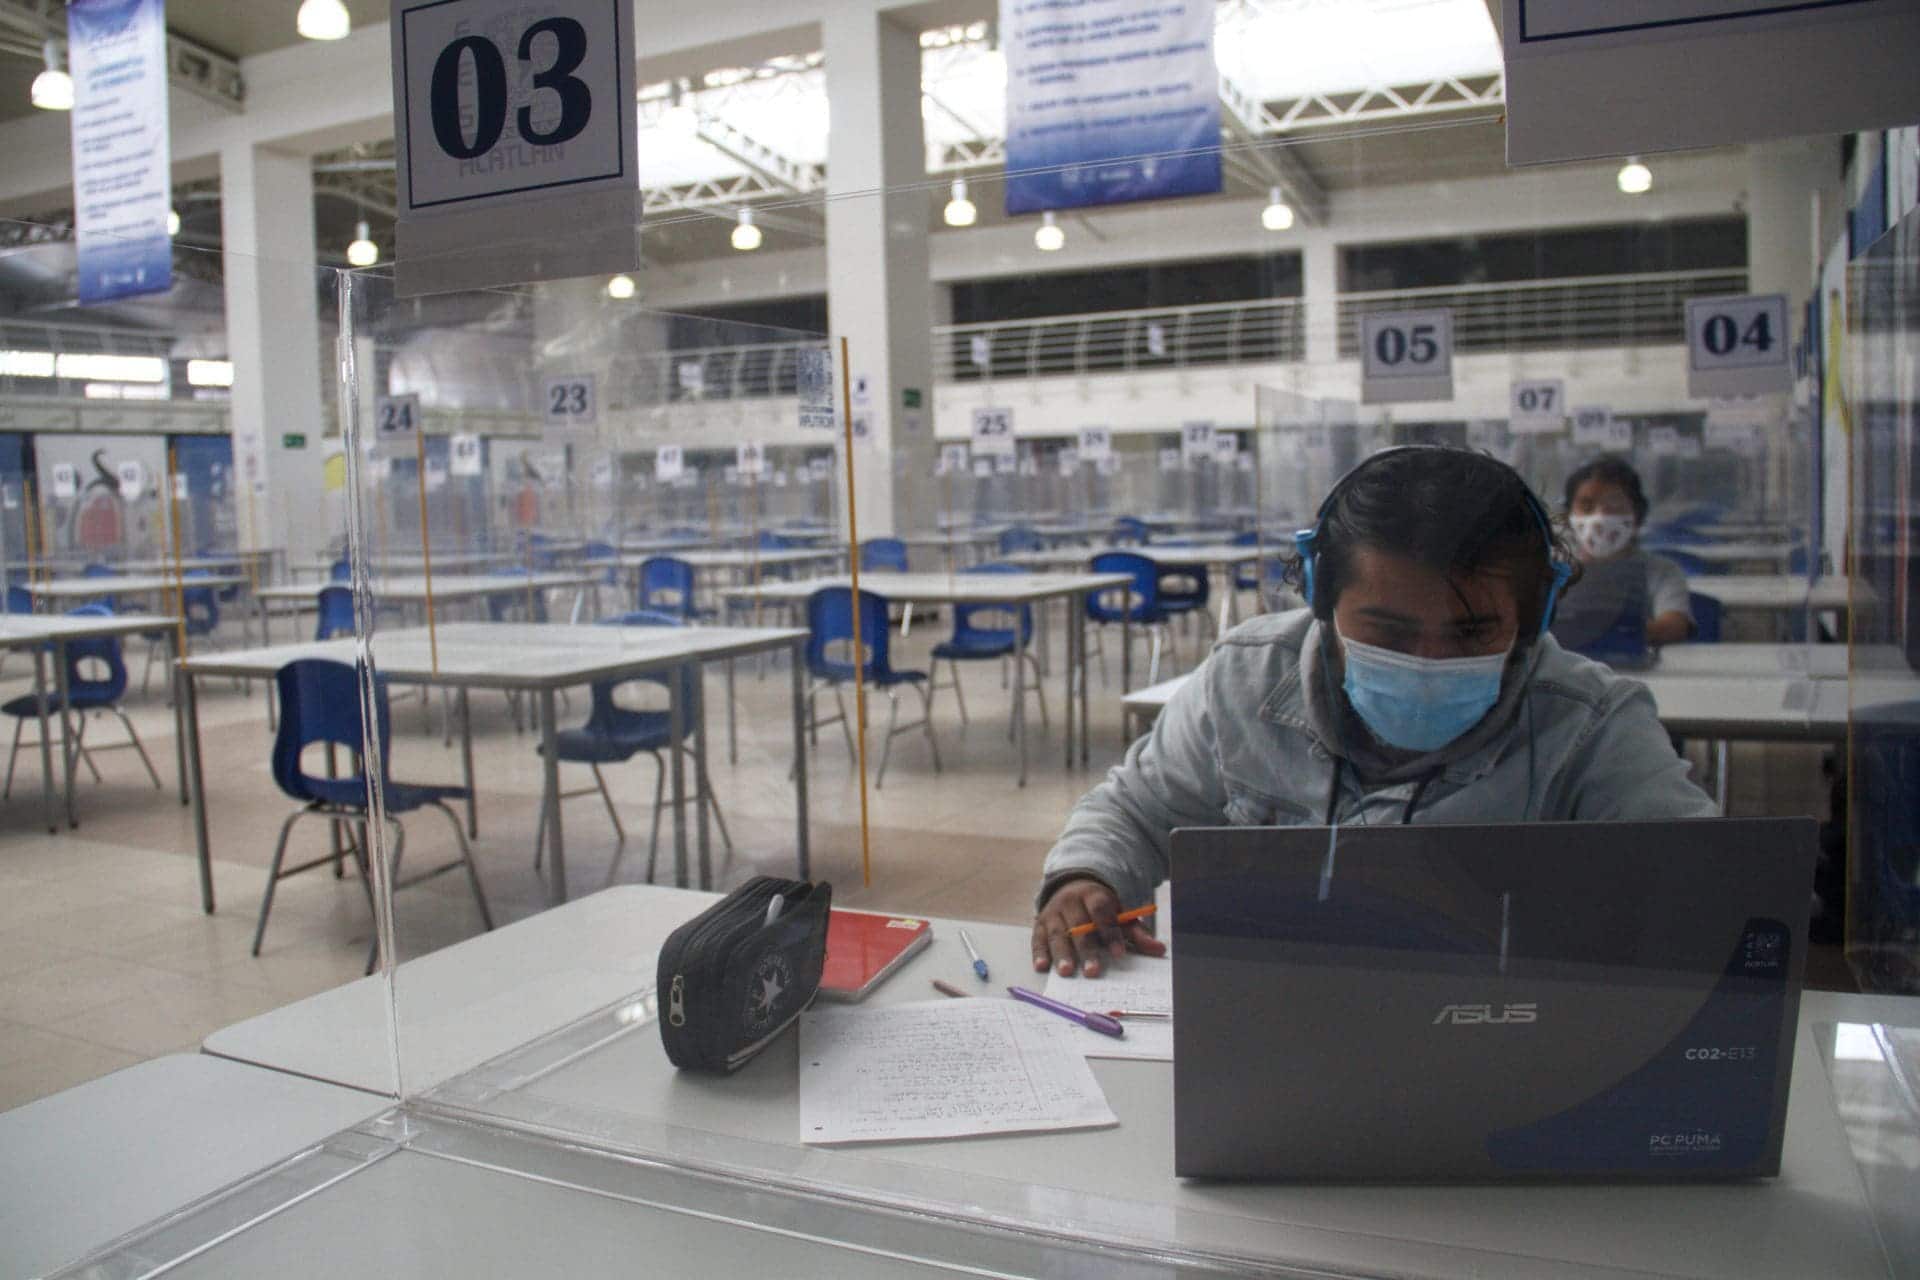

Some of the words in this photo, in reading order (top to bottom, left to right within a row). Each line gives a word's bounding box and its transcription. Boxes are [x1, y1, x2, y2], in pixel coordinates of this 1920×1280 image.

[431, 17, 592, 159] 03
[1376, 326, 1437, 366] 05
[1703, 313, 1774, 355] 04
[551, 384, 587, 414] 23
[1519, 387, 1554, 411] 07
[382, 404, 413, 431] 24
[979, 415, 1007, 435] 25
[1431, 1003, 1537, 1024] ASUS
[1650, 1135, 1671, 1145] PC
[1674, 1134, 1721, 1145] PUMA
